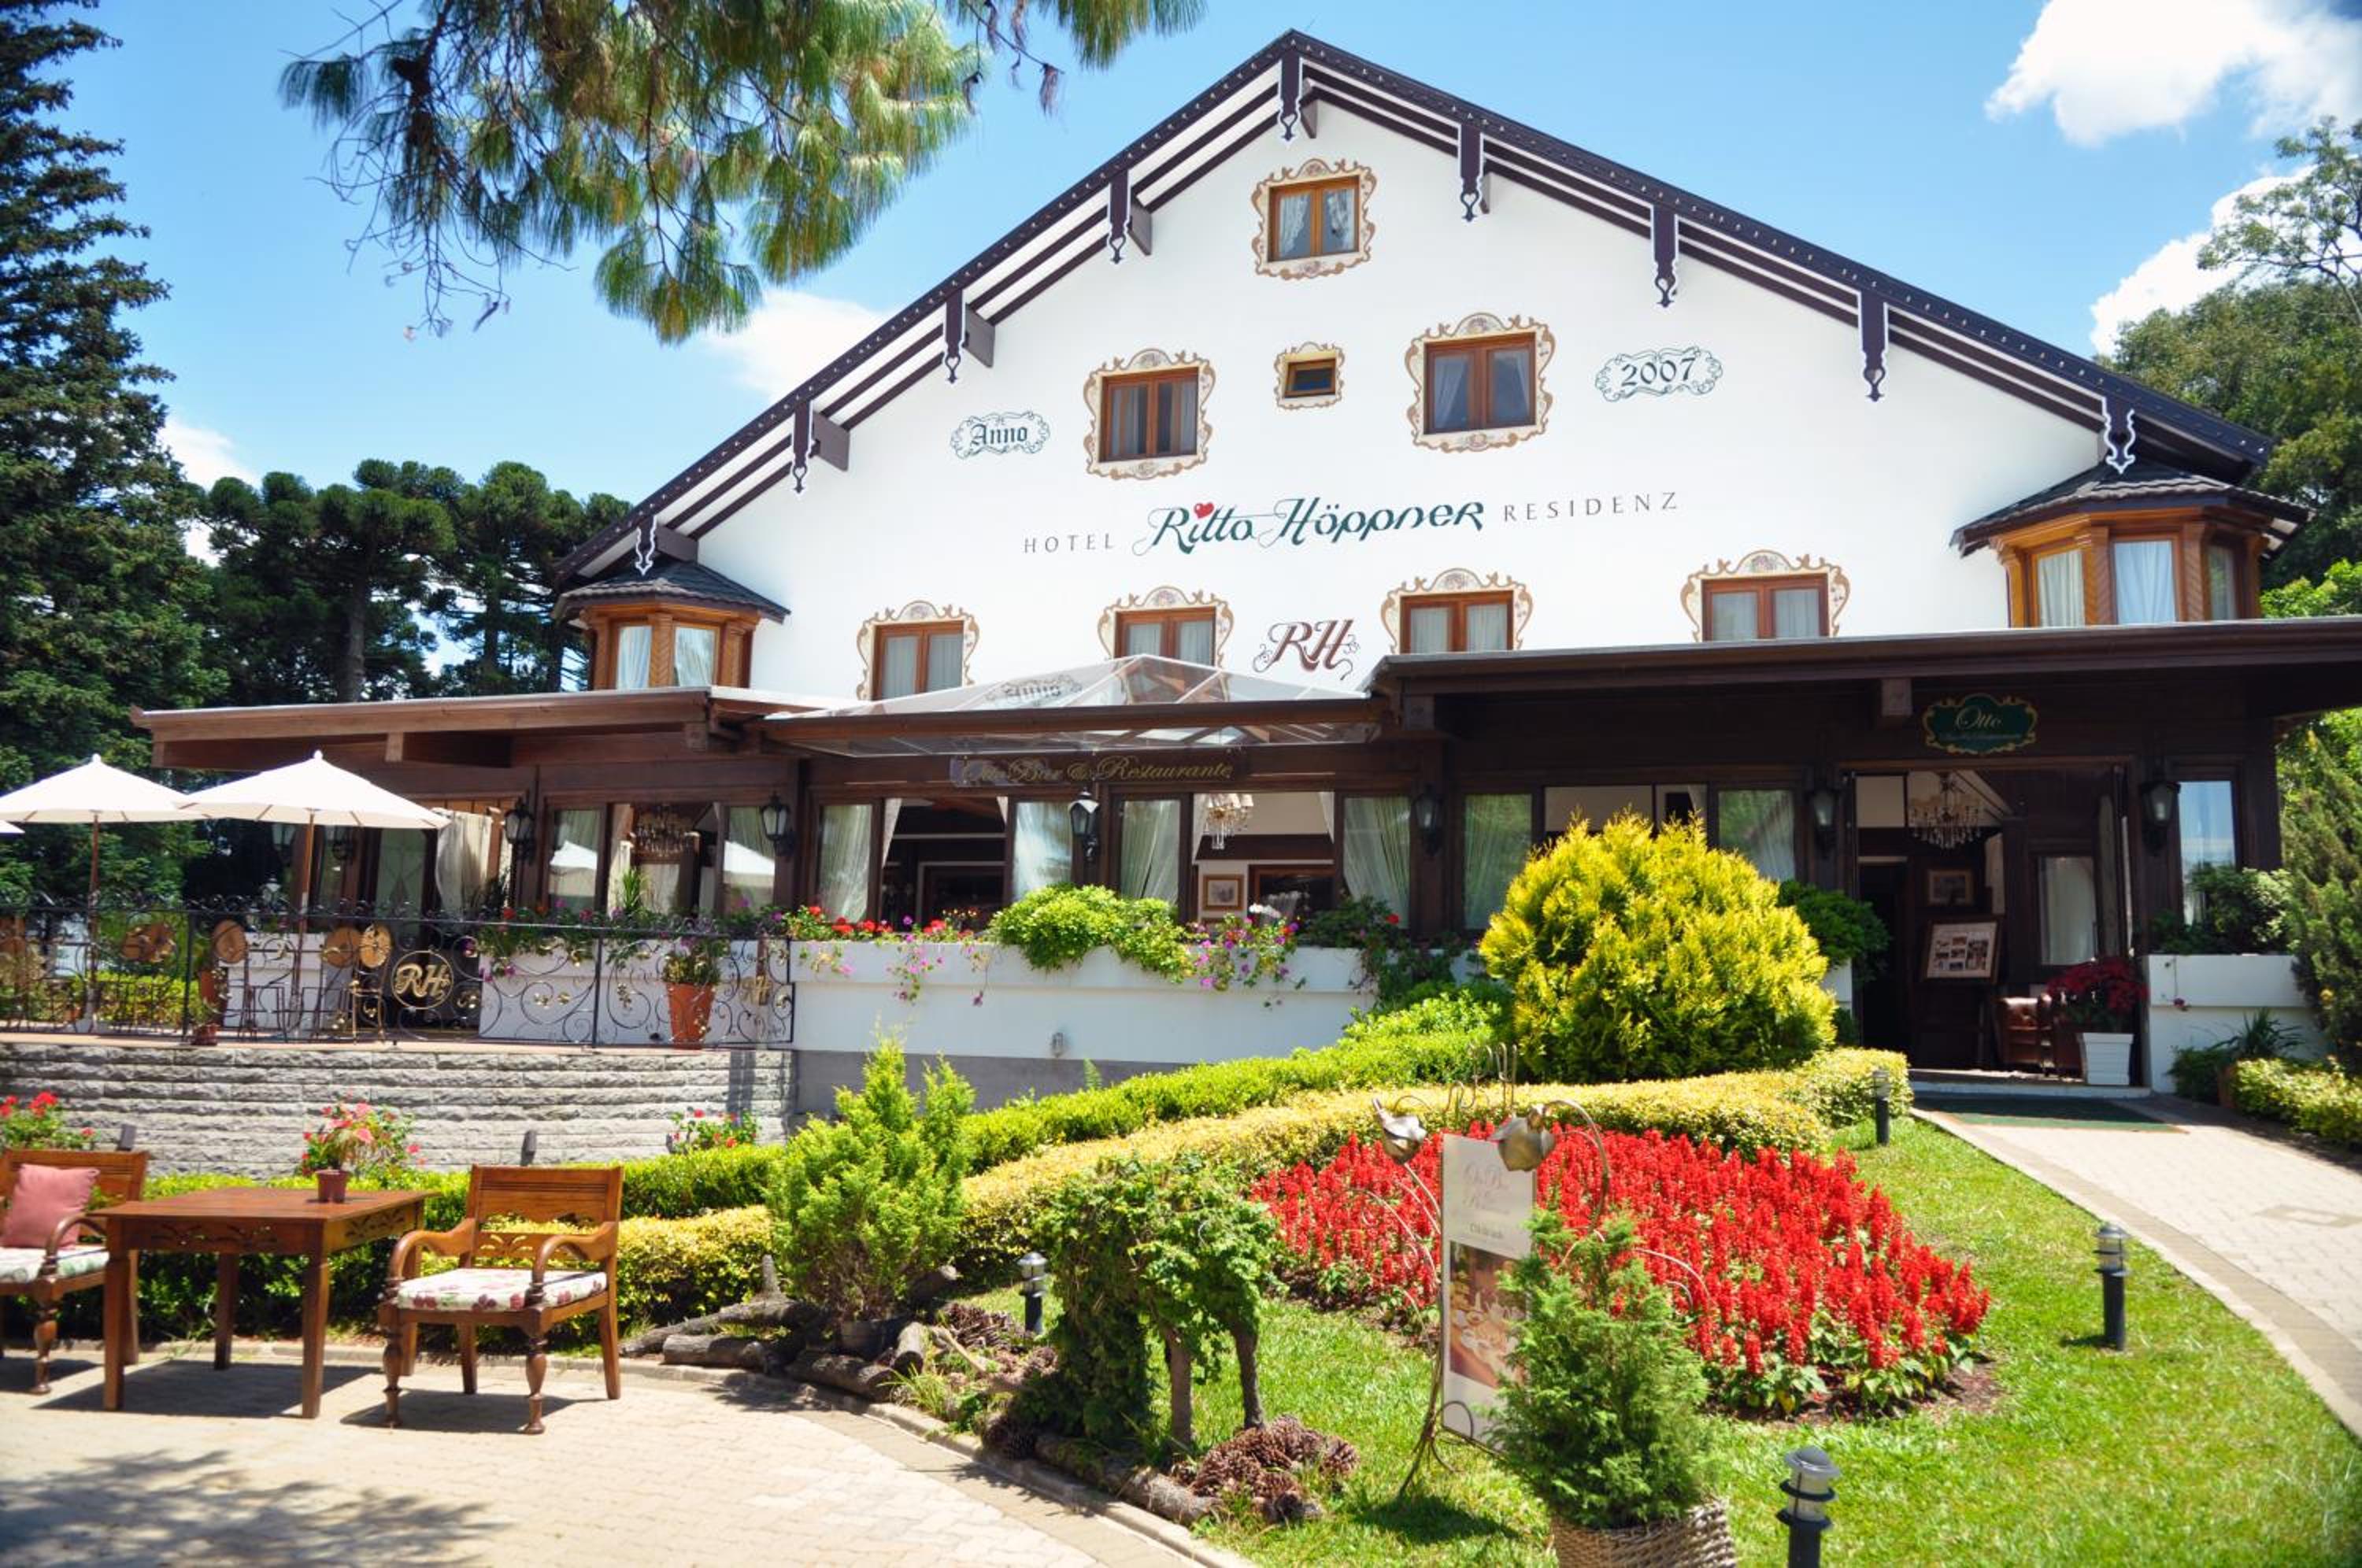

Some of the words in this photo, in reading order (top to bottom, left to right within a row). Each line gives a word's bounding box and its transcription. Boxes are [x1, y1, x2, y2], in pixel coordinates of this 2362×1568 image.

[1621, 357, 1696, 386] 2007
[970, 423, 1027, 446] Anno
[1023, 533, 1115, 553] HOTEL
[1502, 491, 1678, 522] RESIDENZ
[1252, 619, 1360, 681] RH
[1095, 755, 1237, 781] Restaurante
